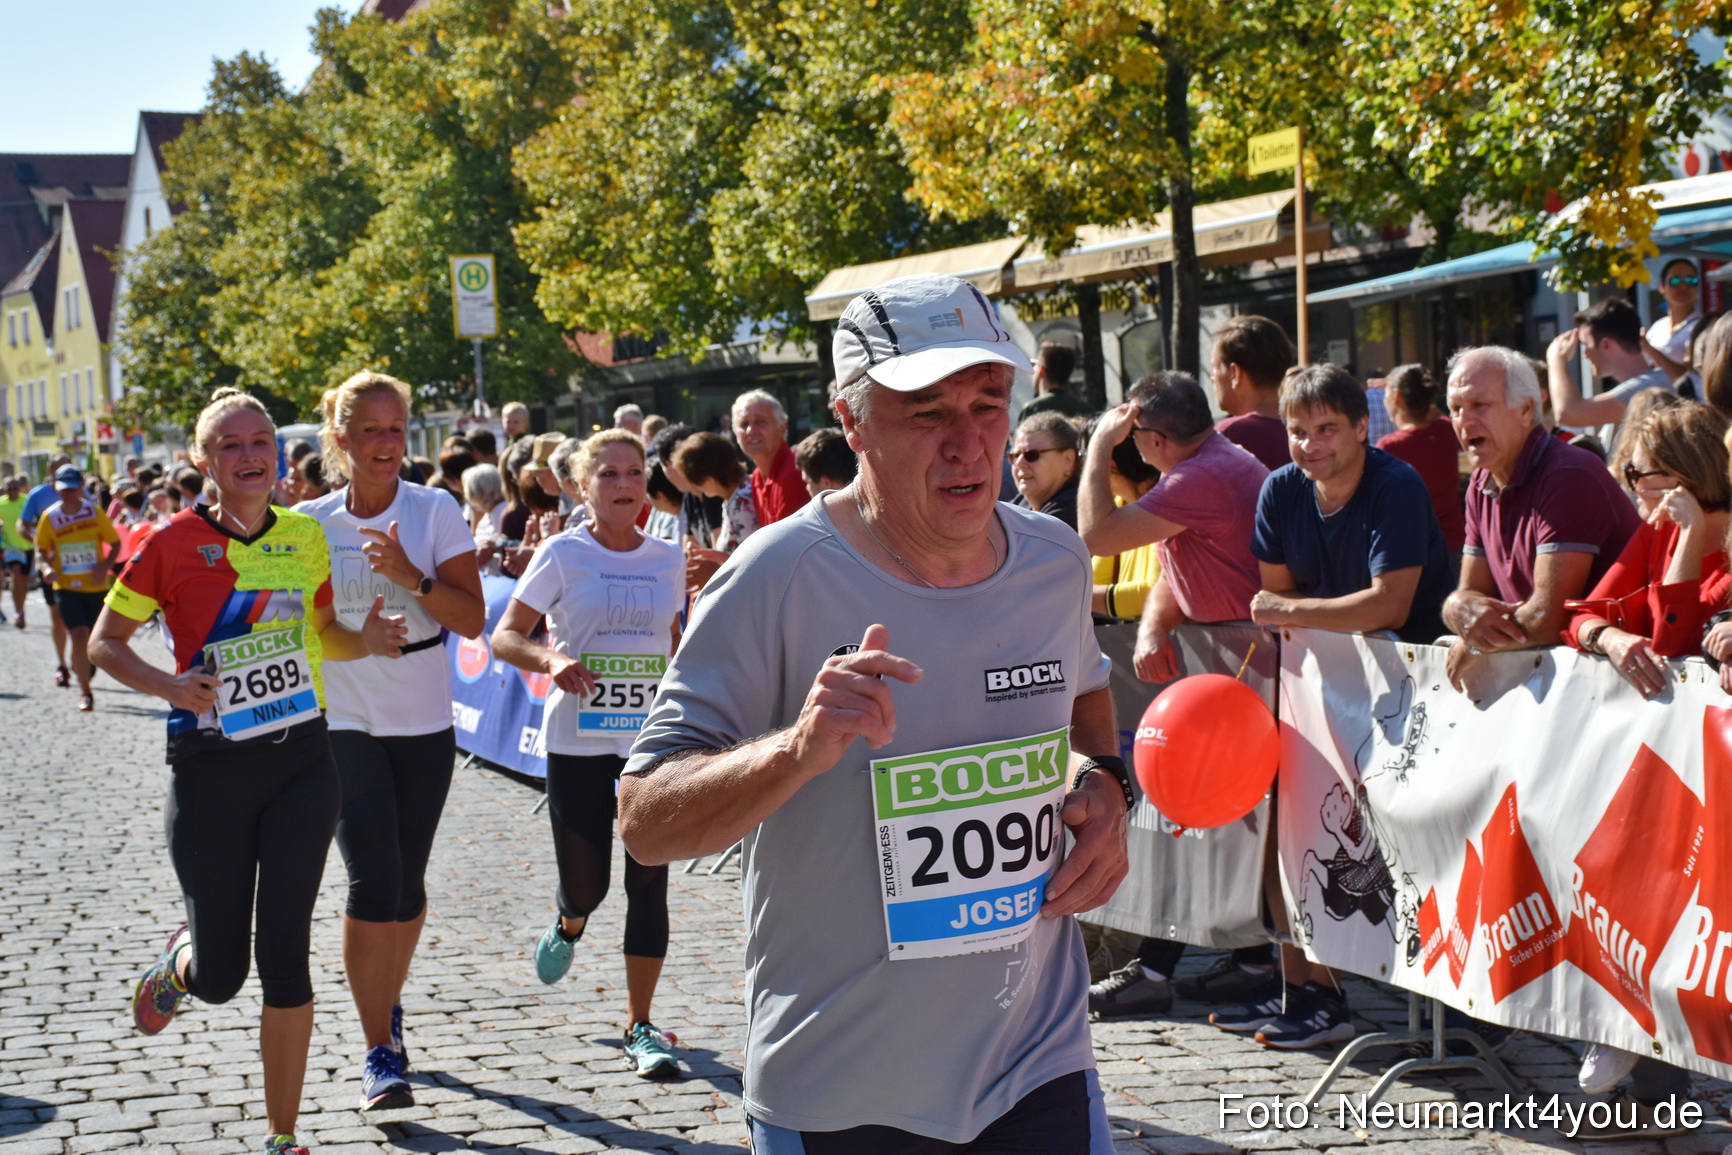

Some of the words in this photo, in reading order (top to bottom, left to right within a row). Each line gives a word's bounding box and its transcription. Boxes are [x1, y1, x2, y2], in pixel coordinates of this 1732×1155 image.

[1258, 142, 1295, 161] Toiletten
[219, 630, 297, 667] BOCK
[588, 656, 661, 675] BOCK
[223, 658, 300, 706] 2689
[985, 660, 1065, 693] BOCK
[985, 693, 1017, 703] inspired
[1019, 691, 1029, 700] by
[1030, 687, 1049, 697] smart
[252, 698, 299, 724] NINA
[590, 683, 658, 708] 2551
[599, 716, 646, 728] JUDIT
[892, 740, 1061, 808] BOCK
[906, 803, 1054, 888] 2090
[1683, 856, 1698, 878] Seit
[1691, 824, 1706, 856] 1929
[949, 886, 1039, 930] JOSEF
[1569, 860, 1648, 990] Braun
[1480, 891, 1553, 971] Braun
[1509, 945, 1534, 968] Sicher
[1533, 940, 1544, 955] ist
[1544, 926, 1567, 948] sicher
[998, 998, 1014, 1009] 16.
